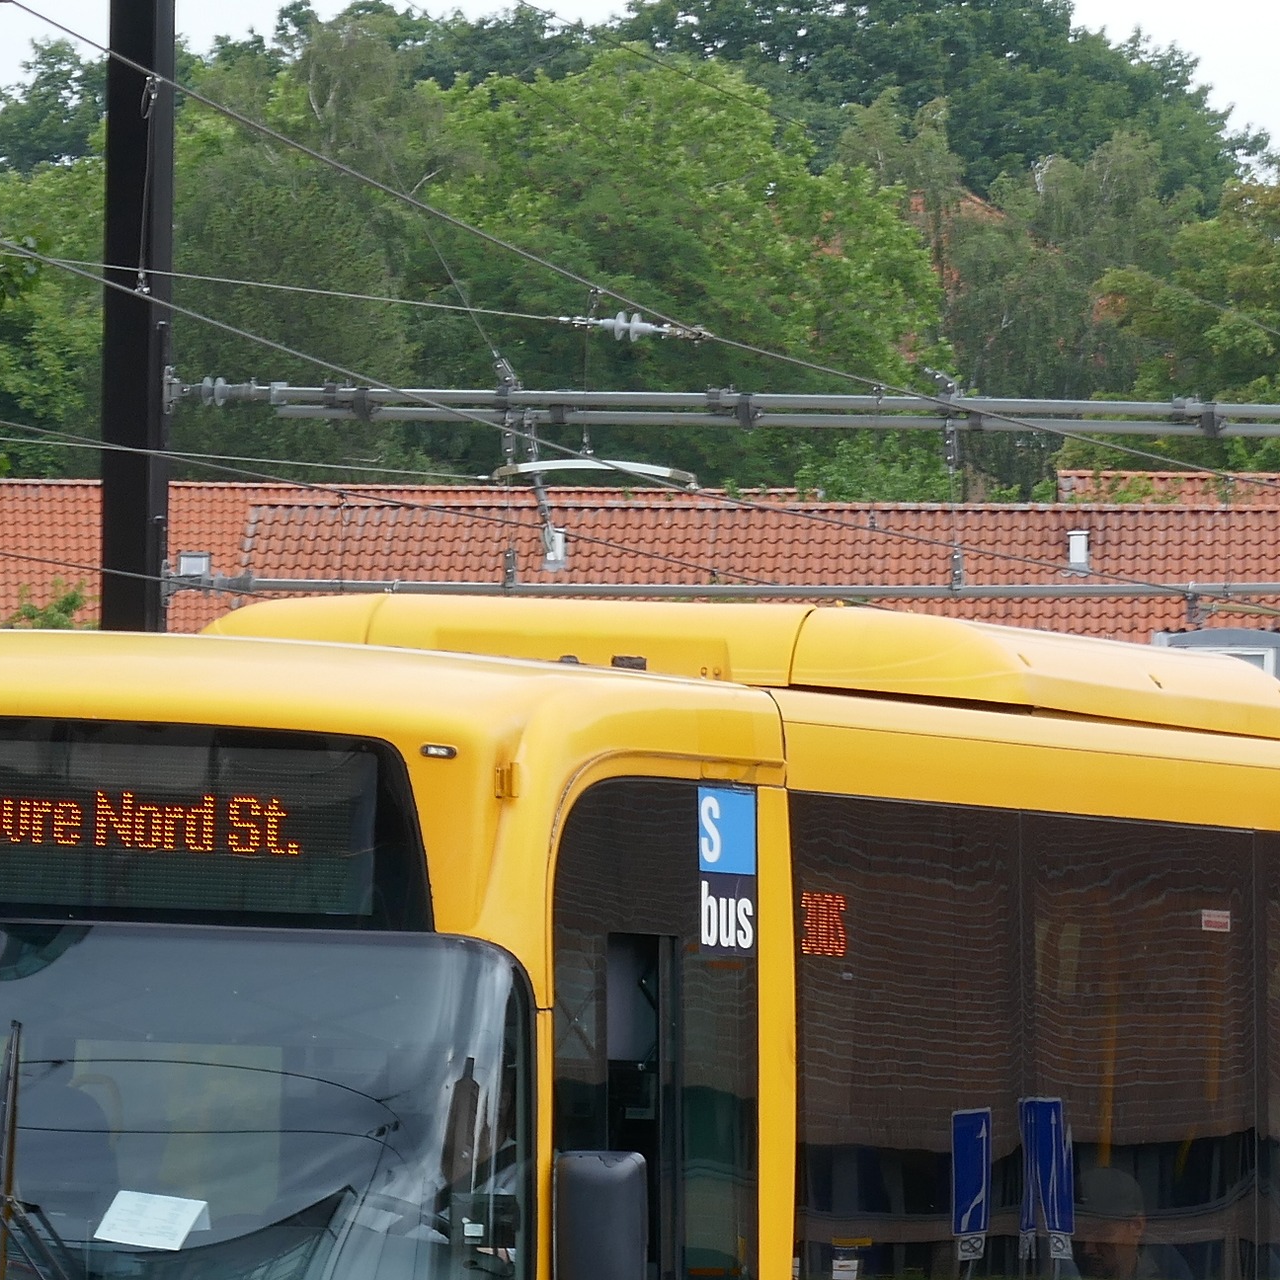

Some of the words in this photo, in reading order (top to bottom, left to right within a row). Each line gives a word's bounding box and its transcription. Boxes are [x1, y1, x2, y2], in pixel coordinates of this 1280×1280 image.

[94, 790, 216, 852] Nord
[228, 797, 300, 856] St.
[700, 795, 721, 863] S
[700, 880, 754, 949] bus
